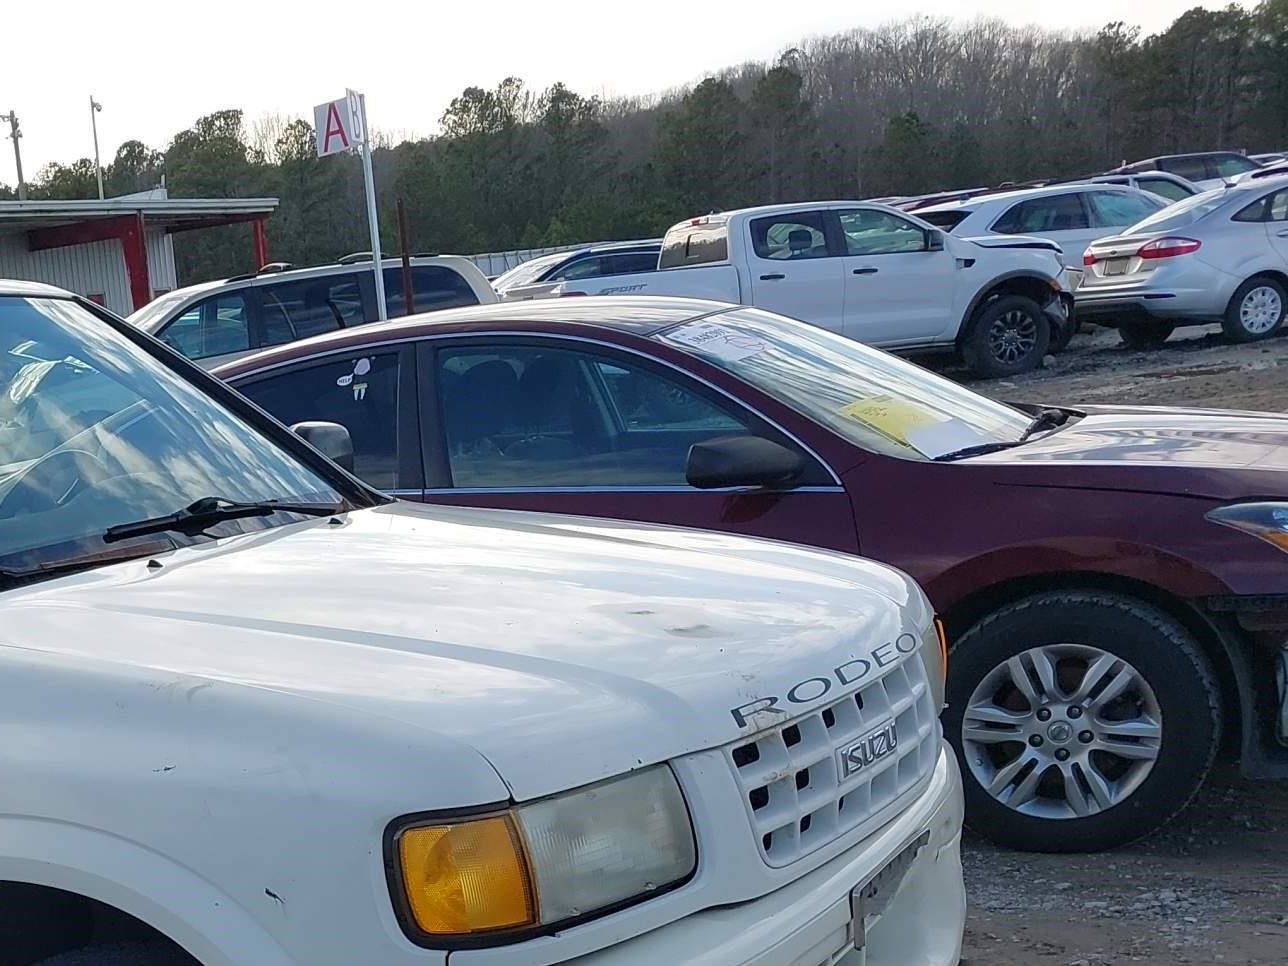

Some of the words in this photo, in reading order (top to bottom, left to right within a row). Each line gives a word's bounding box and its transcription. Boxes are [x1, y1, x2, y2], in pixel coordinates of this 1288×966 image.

[323, 101, 349, 153] A
[730, 632, 917, 729] RODEO
[840, 721, 898, 779] ISUZU
